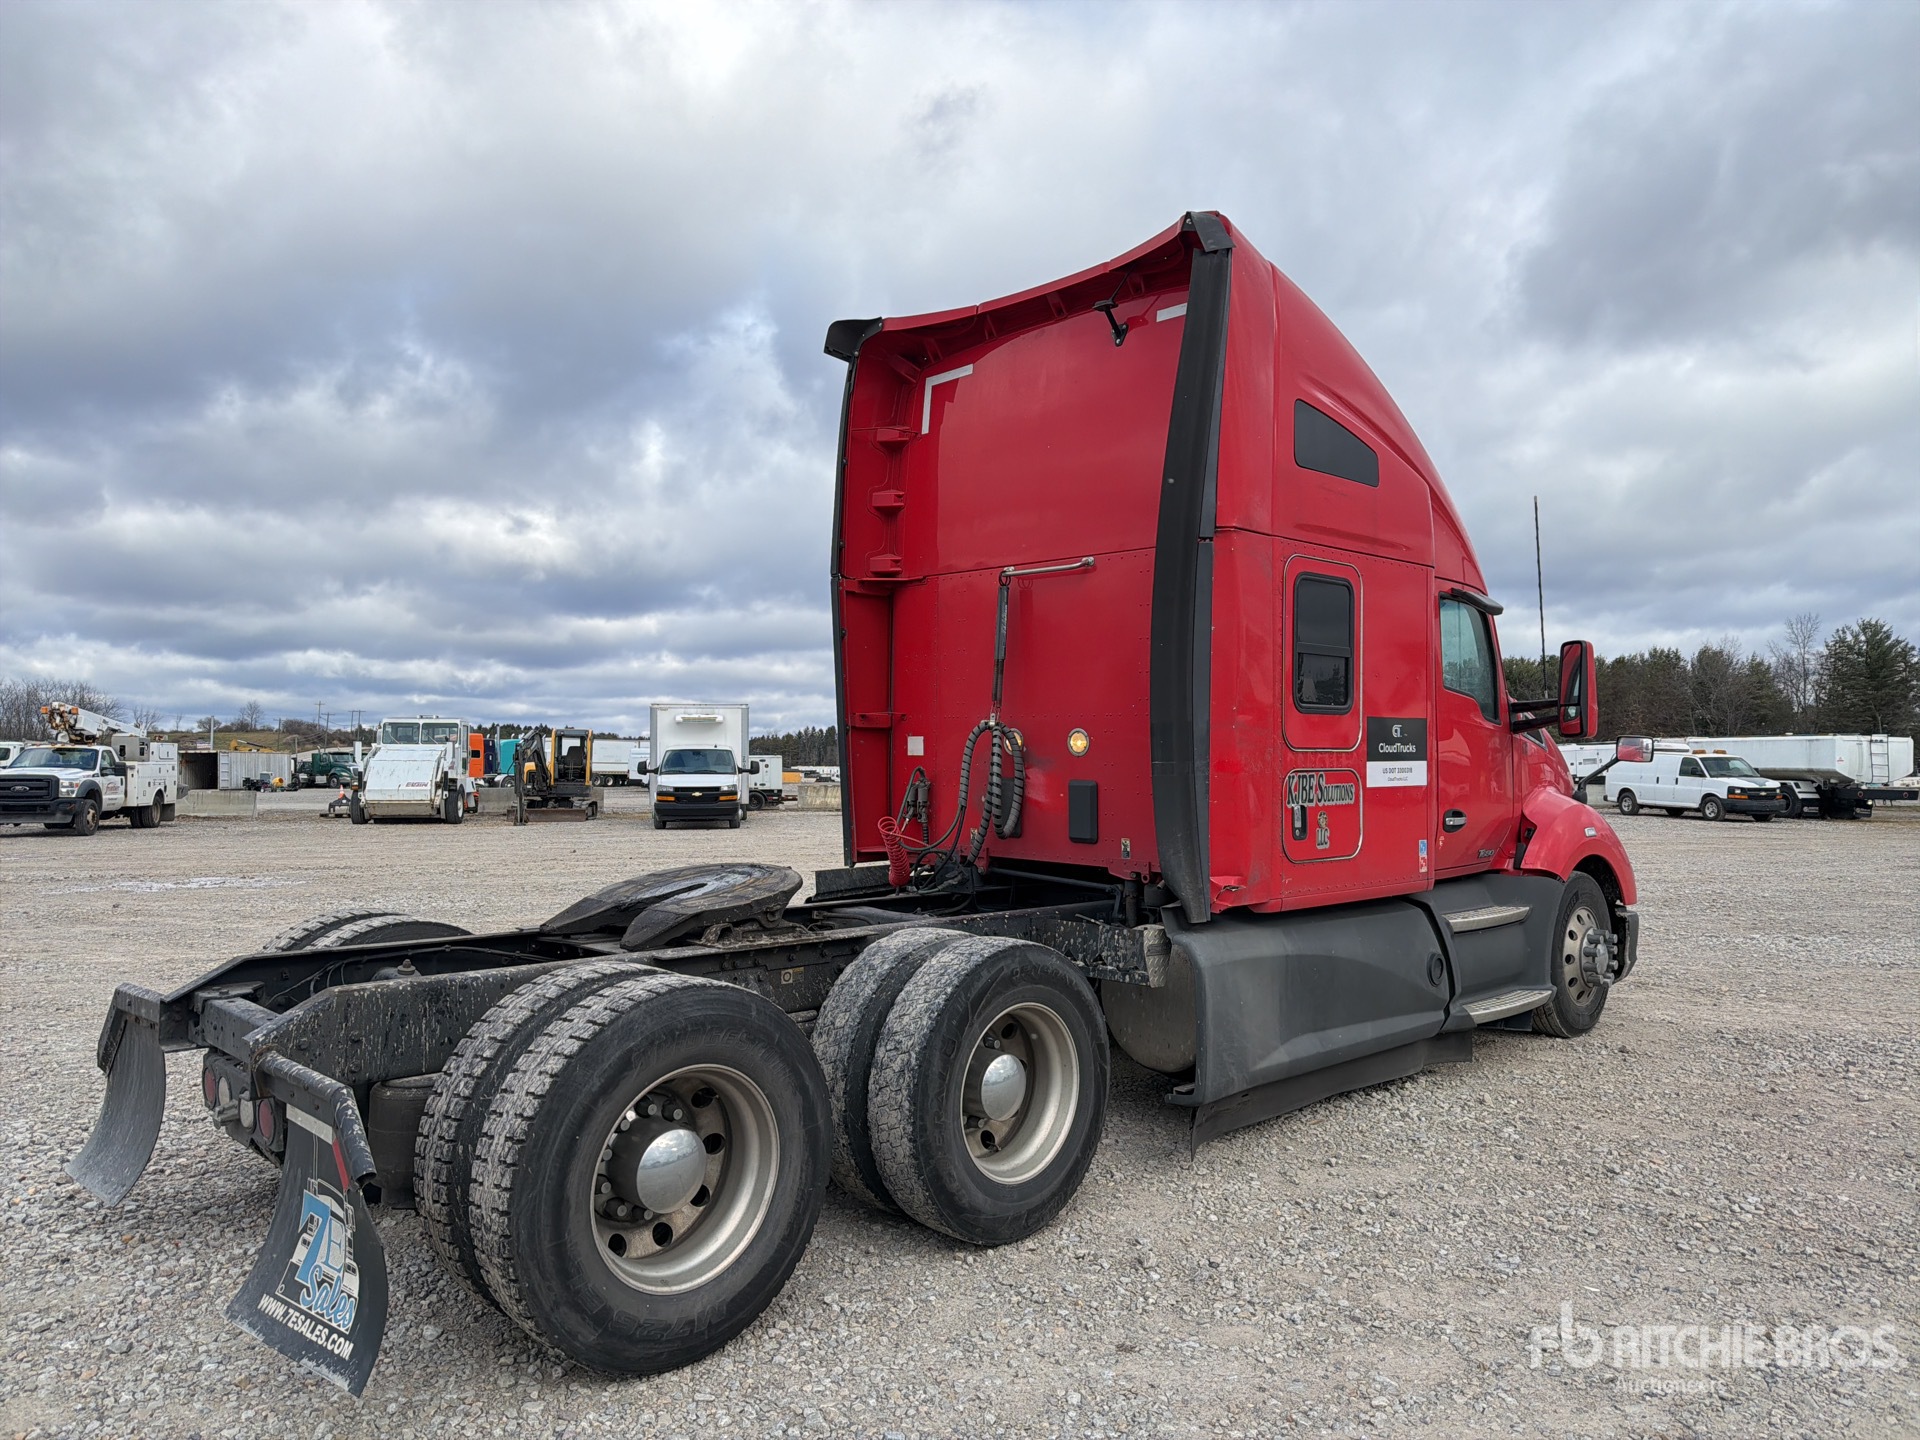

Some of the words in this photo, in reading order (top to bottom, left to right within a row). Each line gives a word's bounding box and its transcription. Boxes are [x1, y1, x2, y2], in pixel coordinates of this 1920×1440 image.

[1378, 742, 1416, 753] CloudTrucks
[1287, 773, 1315, 806] KJBE
[1317, 773, 1354, 804] SOLUTIONS
[1316, 828, 1328, 847] LLC
[299, 1262, 356, 1332] Sales
[257, 1293, 354, 1361] WWW.7ESALES.COM
